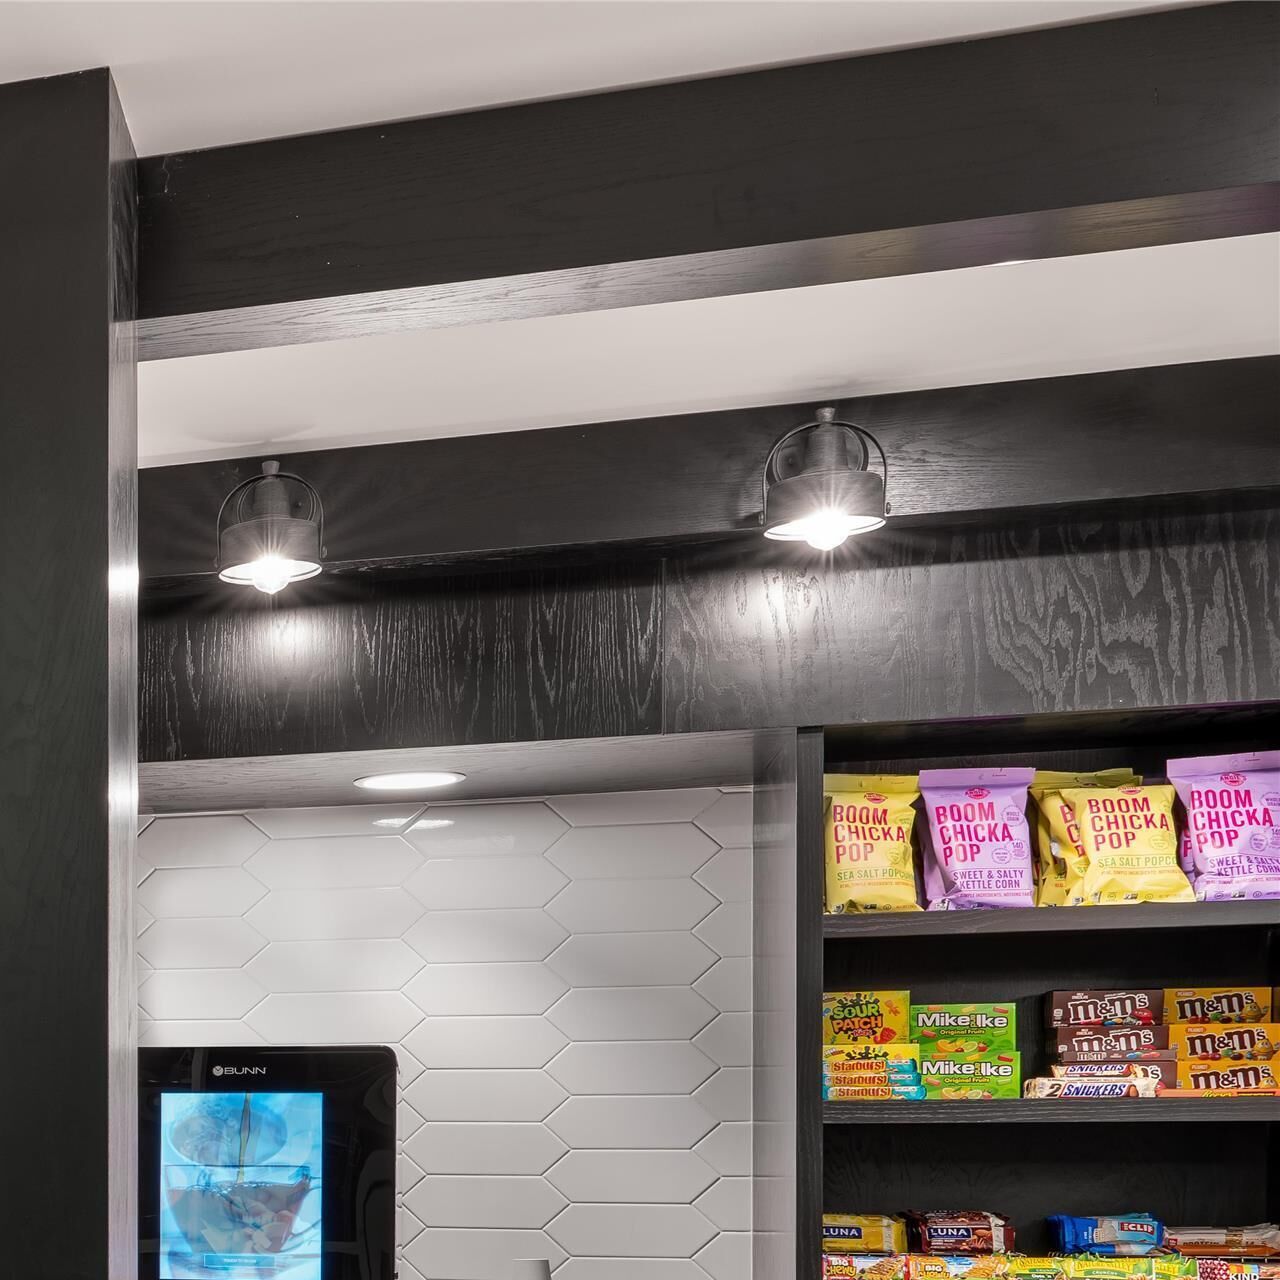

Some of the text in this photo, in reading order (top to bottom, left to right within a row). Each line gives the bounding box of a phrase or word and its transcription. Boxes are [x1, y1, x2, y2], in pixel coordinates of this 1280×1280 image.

[1088, 796, 1151, 814] BOOM
[1191, 788, 1253, 811] BOOM
[833, 804, 889, 826] BOOM
[935, 801, 996, 826] BOOM
[1193, 807, 1274, 831] CHICKA
[1091, 813, 1170, 833] CHICKA
[834, 823, 906, 843] CHICKA
[939, 822, 1014, 846] CHICKA
[1094, 831, 1136, 851] POP
[1196, 828, 1239, 854] POP
[835, 842, 875, 865] POP
[942, 843, 981, 867] POP
[1098, 856, 1142, 868] SEA SALT
[837, 869, 880, 881] SEA SALT
[953, 869, 1024, 882] SWEET & SALTY
[959, 879, 1021, 890] KETTLE CORN
[832, 1003, 880, 1019] SOUR
[831, 1014, 884, 1034] PATCH
[917, 1012, 1008, 1028] Mike Ike
[224, 1066, 266, 1075] BUNN
[922, 1060, 1013, 1077] Mike Ike
[1048, 1083, 1126, 1098] 2 SNICKERS
[823, 1228, 859, 1237] LUNA
[931, 1227, 968, 1236] LUNA
[831, 1258, 849, 1266] BIG
[924, 1265, 942, 1273] BIG
